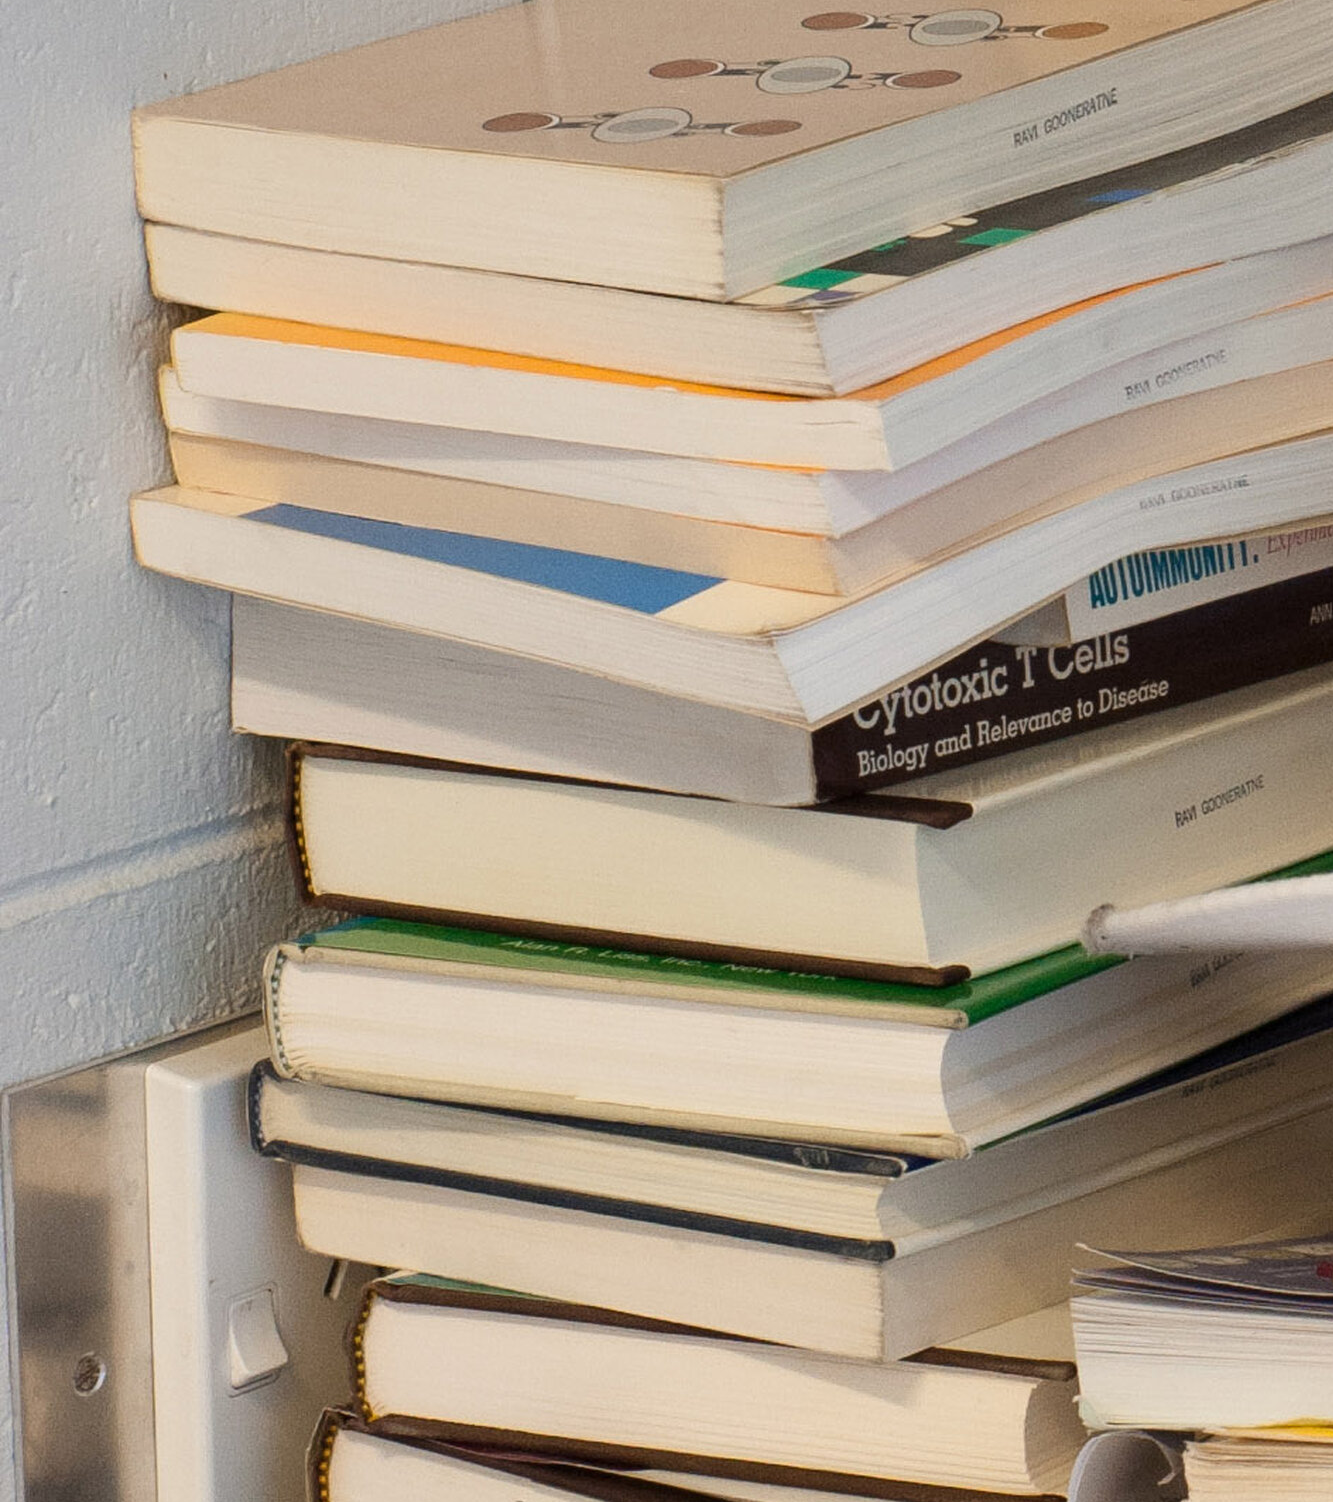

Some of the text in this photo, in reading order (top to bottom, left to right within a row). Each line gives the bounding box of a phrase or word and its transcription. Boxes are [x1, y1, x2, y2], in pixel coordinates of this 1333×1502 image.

[852, 631, 1131, 735] Cytotoxic T Cells
[856, 677, 1170, 777] Biology and Relevance to Disease
